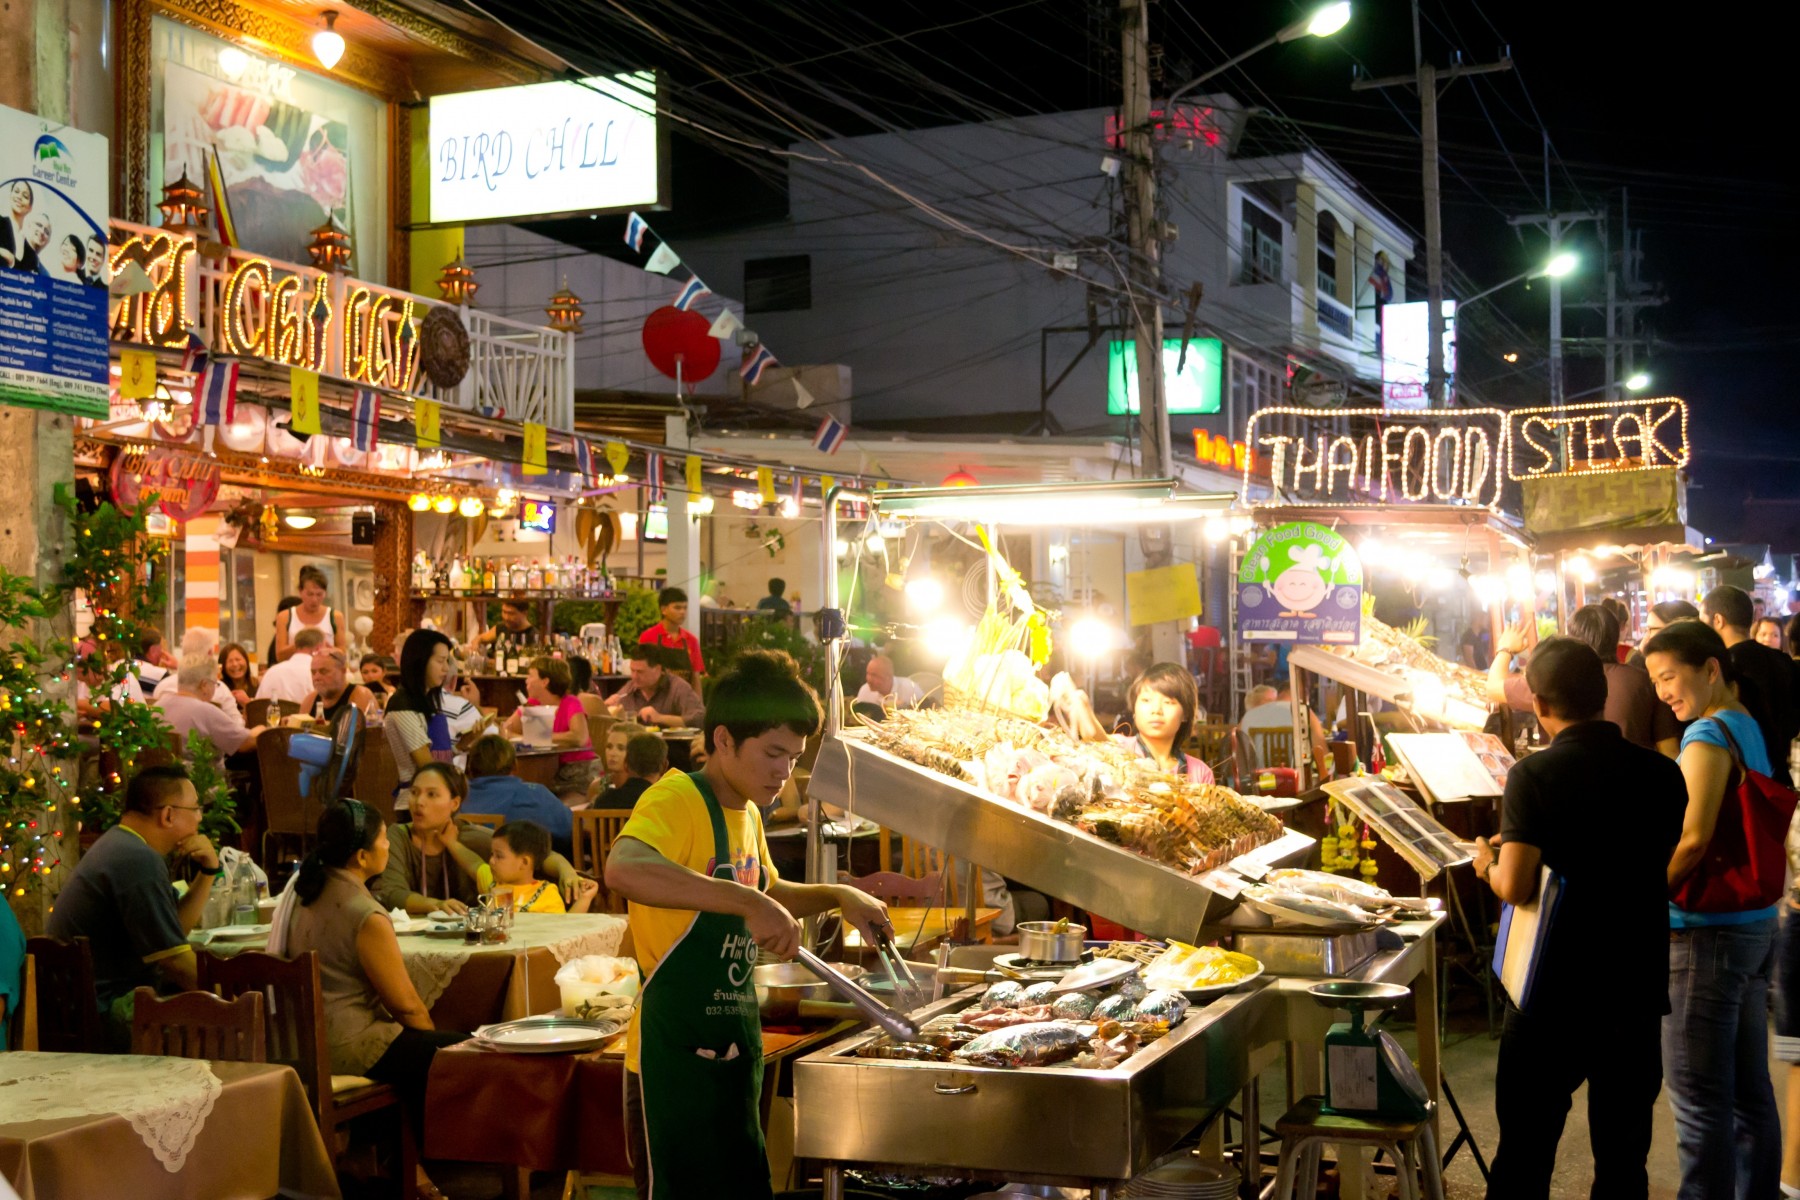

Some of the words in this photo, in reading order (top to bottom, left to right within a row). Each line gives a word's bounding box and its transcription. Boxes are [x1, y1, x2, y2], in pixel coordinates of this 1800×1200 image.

[32, 164, 55, 178] Career
[55, 171, 77, 188] Center
[440, 129, 513, 191] BIRD
[1521, 404, 1682, 473] STEAK
[1242, 544, 1268, 581] Clean
[1266, 525, 1300, 547] Food
[1304, 525, 1341, 549] Good
